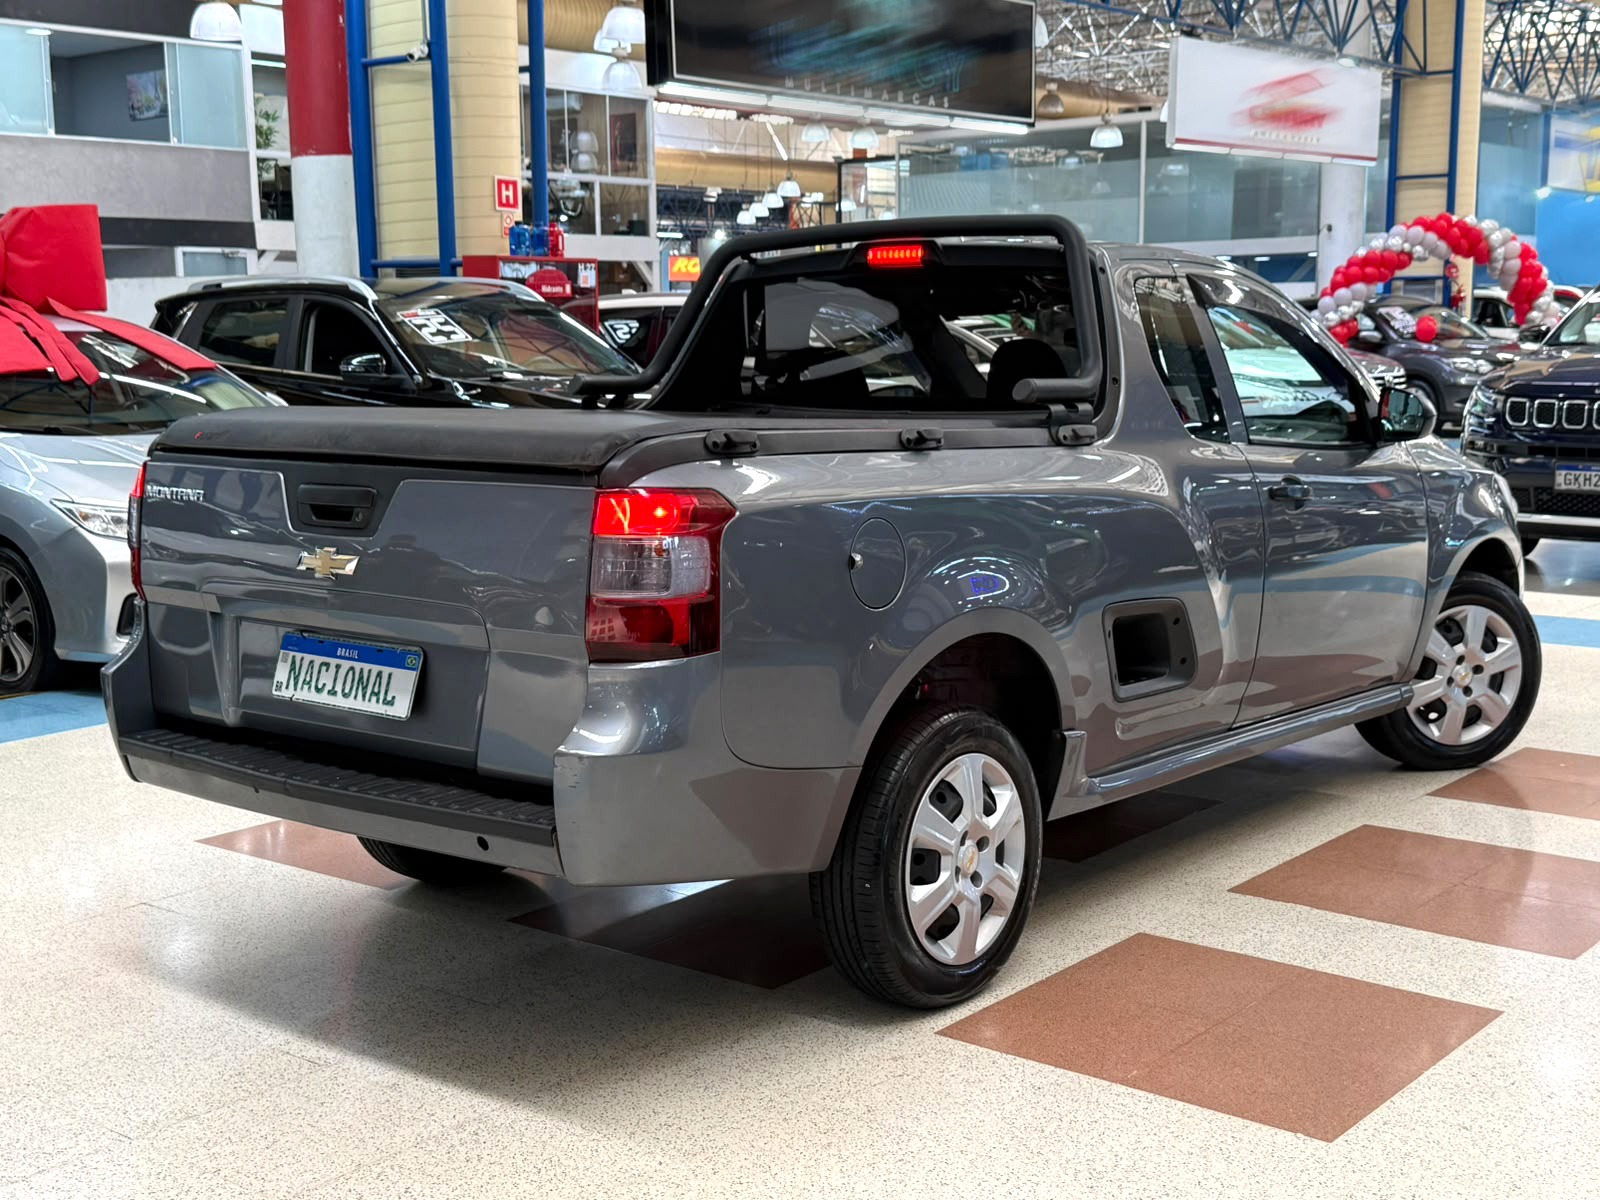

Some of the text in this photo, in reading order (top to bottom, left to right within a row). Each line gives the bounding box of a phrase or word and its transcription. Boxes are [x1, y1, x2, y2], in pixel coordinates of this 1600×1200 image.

[785, 75, 949, 108] MULTIMARCAS
[501, 183, 514, 205] H
[411, 317, 466, 340] 25
[147, 485, 204, 503] MONTANA
[336, 647, 358, 659] BRASIL
[274, 680, 283, 692] BR
[285, 655, 396, 707] NACIONAL
